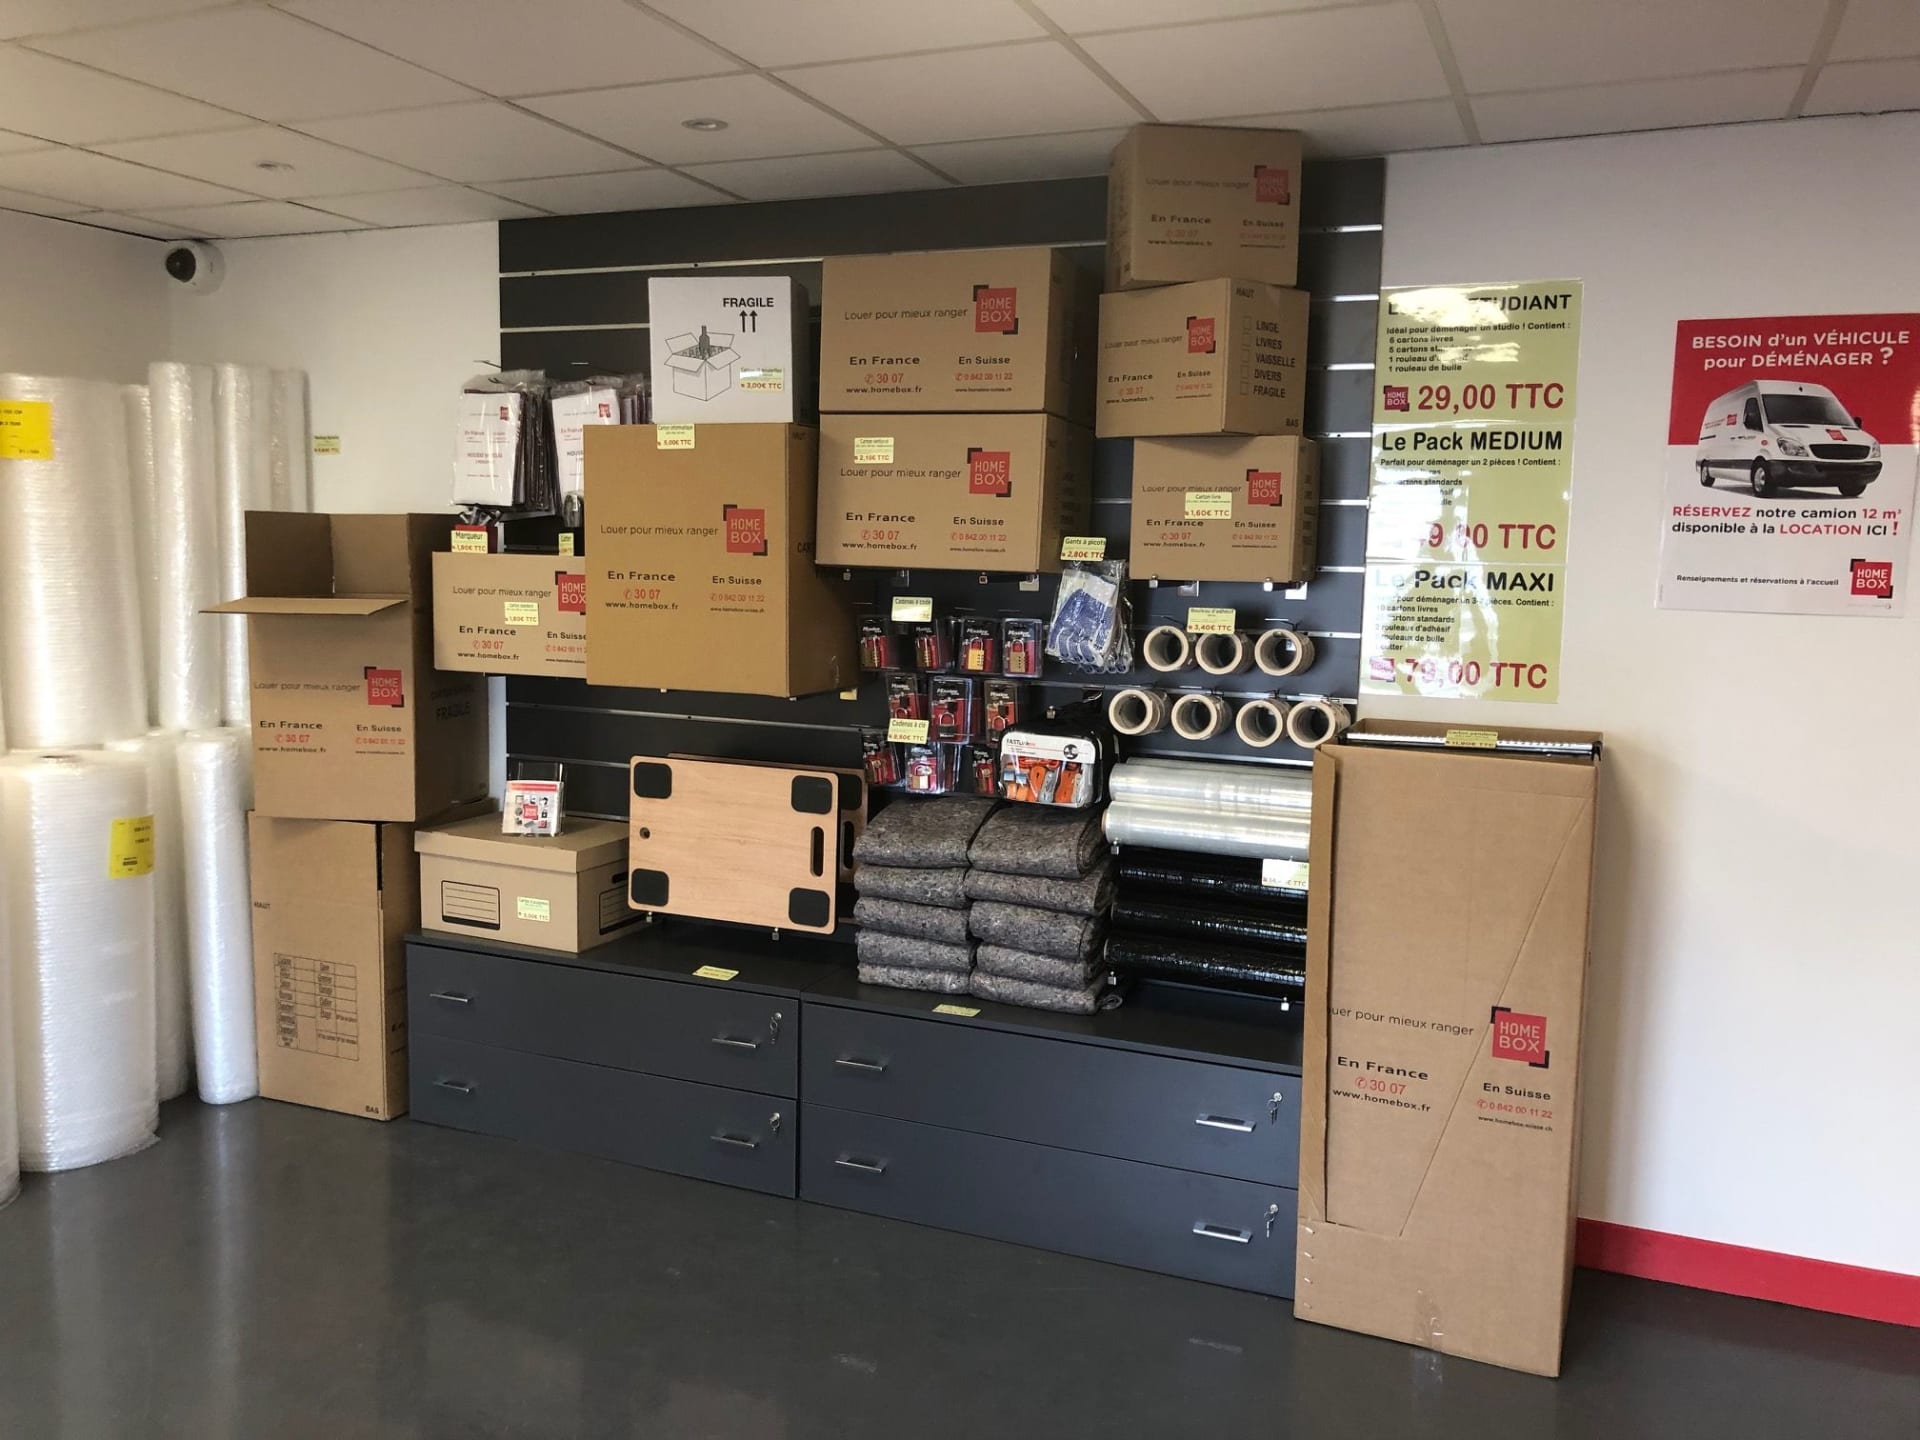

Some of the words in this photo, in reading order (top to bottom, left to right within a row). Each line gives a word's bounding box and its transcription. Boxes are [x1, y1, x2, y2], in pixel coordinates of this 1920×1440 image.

[723, 298, 774, 308] FRAGILE
[981, 297, 1011, 309] HOME
[845, 311, 872, 320] Louer
[876, 310, 898, 320] pour
[901, 310, 930, 318] mieux
[934, 308, 967, 319] ranger
[980, 311, 1012, 322] BOX
[1256, 320, 1279, 333] LINGE
[1431, 325, 1478, 333] déménager
[1493, 323, 1519, 331] studio
[1528, 322, 1565, 330] Contient
[1256, 338, 1282, 349] LIVRES
[1692, 335, 1761, 349] BESOIN
[1768, 334, 1807, 347] d'un
[1814, 330, 1909, 345] VÉHICULE
[849, 357, 866, 365] En
[872, 356, 920, 365] France
[975, 356, 1010, 364] Suisse
[1256, 353, 1296, 368] VAISSELLE
[1704, 355, 1745, 370] pour
[1752, 351, 1872, 367] DÉMÉNAGER
[1880, 347, 1893, 365] ?
[1254, 370, 1281, 381] DIVERS
[1253, 385, 1285, 398] FRAGILE
[1387, 397, 1407, 405] BOX
[1418, 384, 1496, 414] 29,00
[1506, 383, 1564, 409] TTC
[1286, 418, 1298, 427] BAS
[1382, 432, 1406, 451] Le
[1414, 432, 1463, 451] Pack
[1471, 431, 1562, 450] MEDIUM
[975, 461, 1005, 472] HOME
[1427, 458, 1469, 466] déménager
[974, 474, 1005, 485] BOX
[1252, 480, 1278, 488] HOME
[1252, 489, 1277, 498] BOX
[1672, 504, 1751, 517] RÉSERVEZ
[1756, 508, 1796, 518] notre
[1801, 508, 1856, 519] camion
[1863, 508, 1877, 519] 12
[846, 512, 862, 521] En
[868, 512, 915, 523] France
[953, 517, 966, 525] En
[970, 517, 1004, 526] Suisse
[731, 518, 760, 530] HOME
[1672, 522, 1745, 534] disponible
[1750, 523, 1758, 534] à
[1763, 523, 1775, 534] la
[1780, 524, 1861, 535] LOCATION
[1867, 525, 1887, 535] ICI
[1893, 521, 1898, 536] !
[456, 532, 483, 540] Marqueur
[601, 525, 627, 535] Louer
[630, 526, 652, 536] pour
[655, 526, 683, 535] mieux
[687, 527, 718, 537] ranger
[873, 530, 884, 540] 30
[887, 531, 899, 541] 07
[1498, 524, 1556, 549] TTC
[731, 531, 761, 544] BOX
[608, 571, 624, 580] En
[630, 571, 675, 582] France
[1858, 568, 1888, 580] HOME
[712, 576, 725, 584] En
[729, 576, 762, 585] Suisse
[1415, 570, 1477, 590] Pack
[1486, 571, 1554, 592] MAXI
[1677, 575, 1738, 584] Renseignements
[1750, 577, 1797, 585] réservations
[1806, 578, 1839, 586] l'accueil
[1855, 578, 1886, 589] BOX
[478, 627, 516, 635] France
[1490, 662, 1547, 688] TTC
[372, 678, 398, 686] HOME
[372, 688, 398, 698] BOX
[280, 721, 322, 729] France
[1355, 1010, 1384, 1023] pour
[1388, 1016, 1427, 1030] mieux
[1431, 1022, 1474, 1036] ranger
[1500, 1021, 1540, 1038] HOME
[1499, 1037, 1540, 1053] BOX
[1337, 1056, 1359, 1069] En
[1366, 1061, 1429, 1081] France
[1370, 1080, 1386, 1092] 30
[1390, 1083, 1407, 1095] 07
[1483, 1082, 1501, 1093] En
[1505, 1086, 1551, 1101] Suisse
[1332, 1088, 1431, 1113] www.homebox.fr
[365, 1105, 379, 1114] BAS
[1489, 1102, 1495, 1110] 0
[1497, 1103, 1513, 1113] 842
[1515, 1105, 1527, 1114] 00
[1530, 1108, 1538, 1116] 11
[1542, 1110, 1552, 1119] 22
